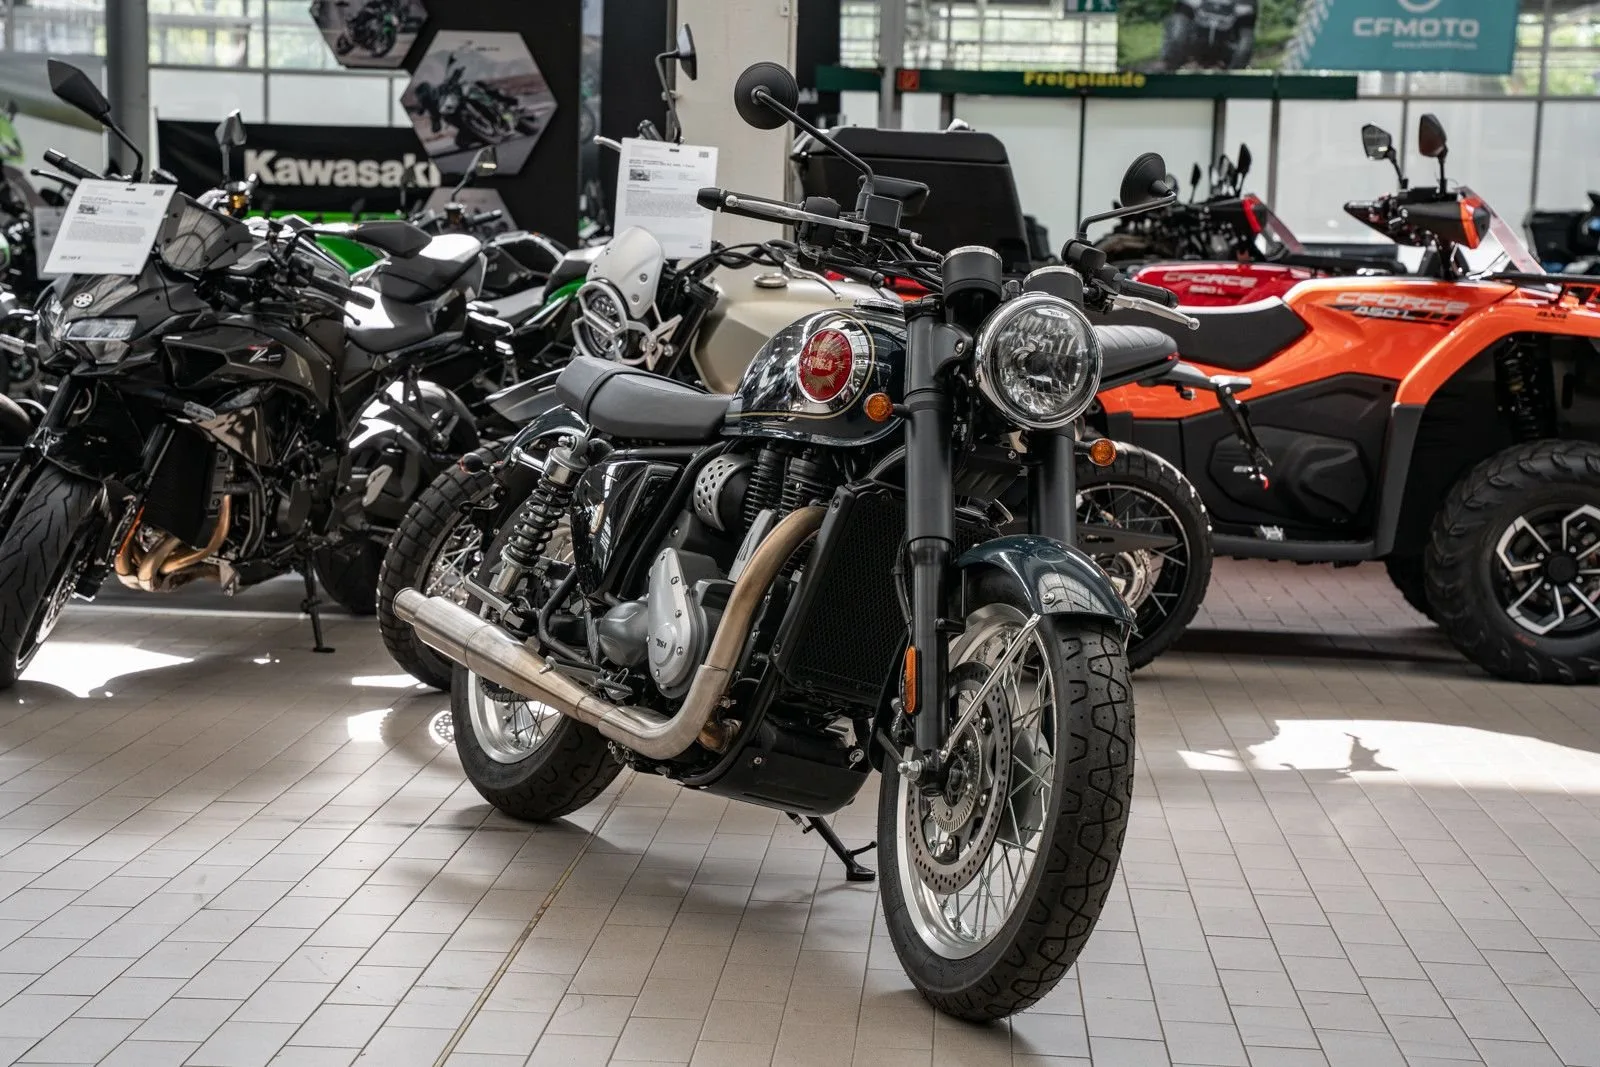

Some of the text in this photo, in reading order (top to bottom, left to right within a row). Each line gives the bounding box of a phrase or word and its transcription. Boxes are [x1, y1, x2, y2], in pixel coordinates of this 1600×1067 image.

[1353, 16, 1480, 38] CFMOTO
[244, 149, 442, 188] Kawasaki
[1335, 291, 1470, 315] CFORCE
